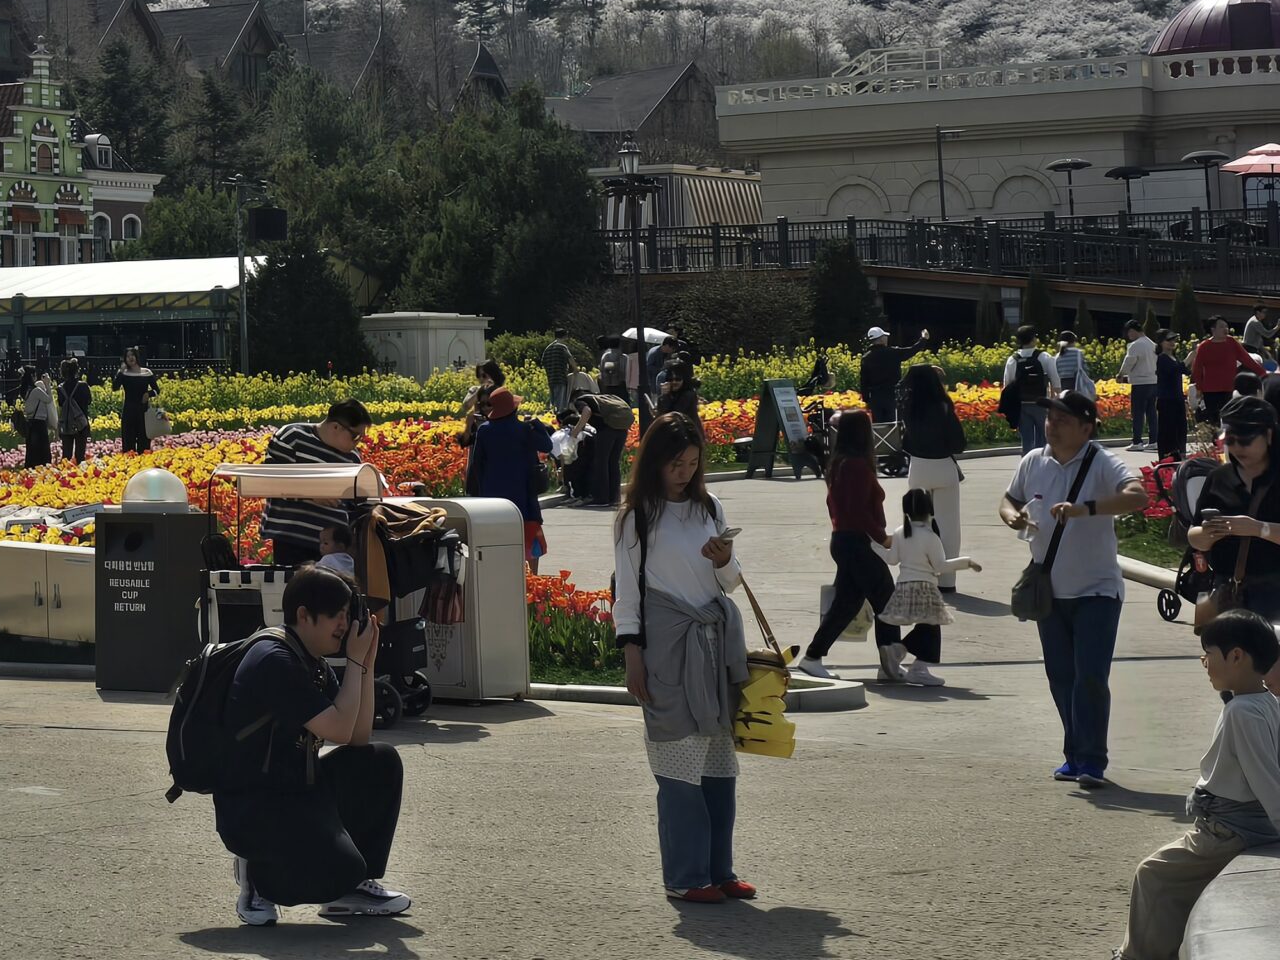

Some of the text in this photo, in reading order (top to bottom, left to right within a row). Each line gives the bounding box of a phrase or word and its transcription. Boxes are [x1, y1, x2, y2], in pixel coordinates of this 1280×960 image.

[109, 578, 150, 588] REUSABLE
[121, 591, 139, 599] CUP
[114, 602, 146, 612] RETURN
